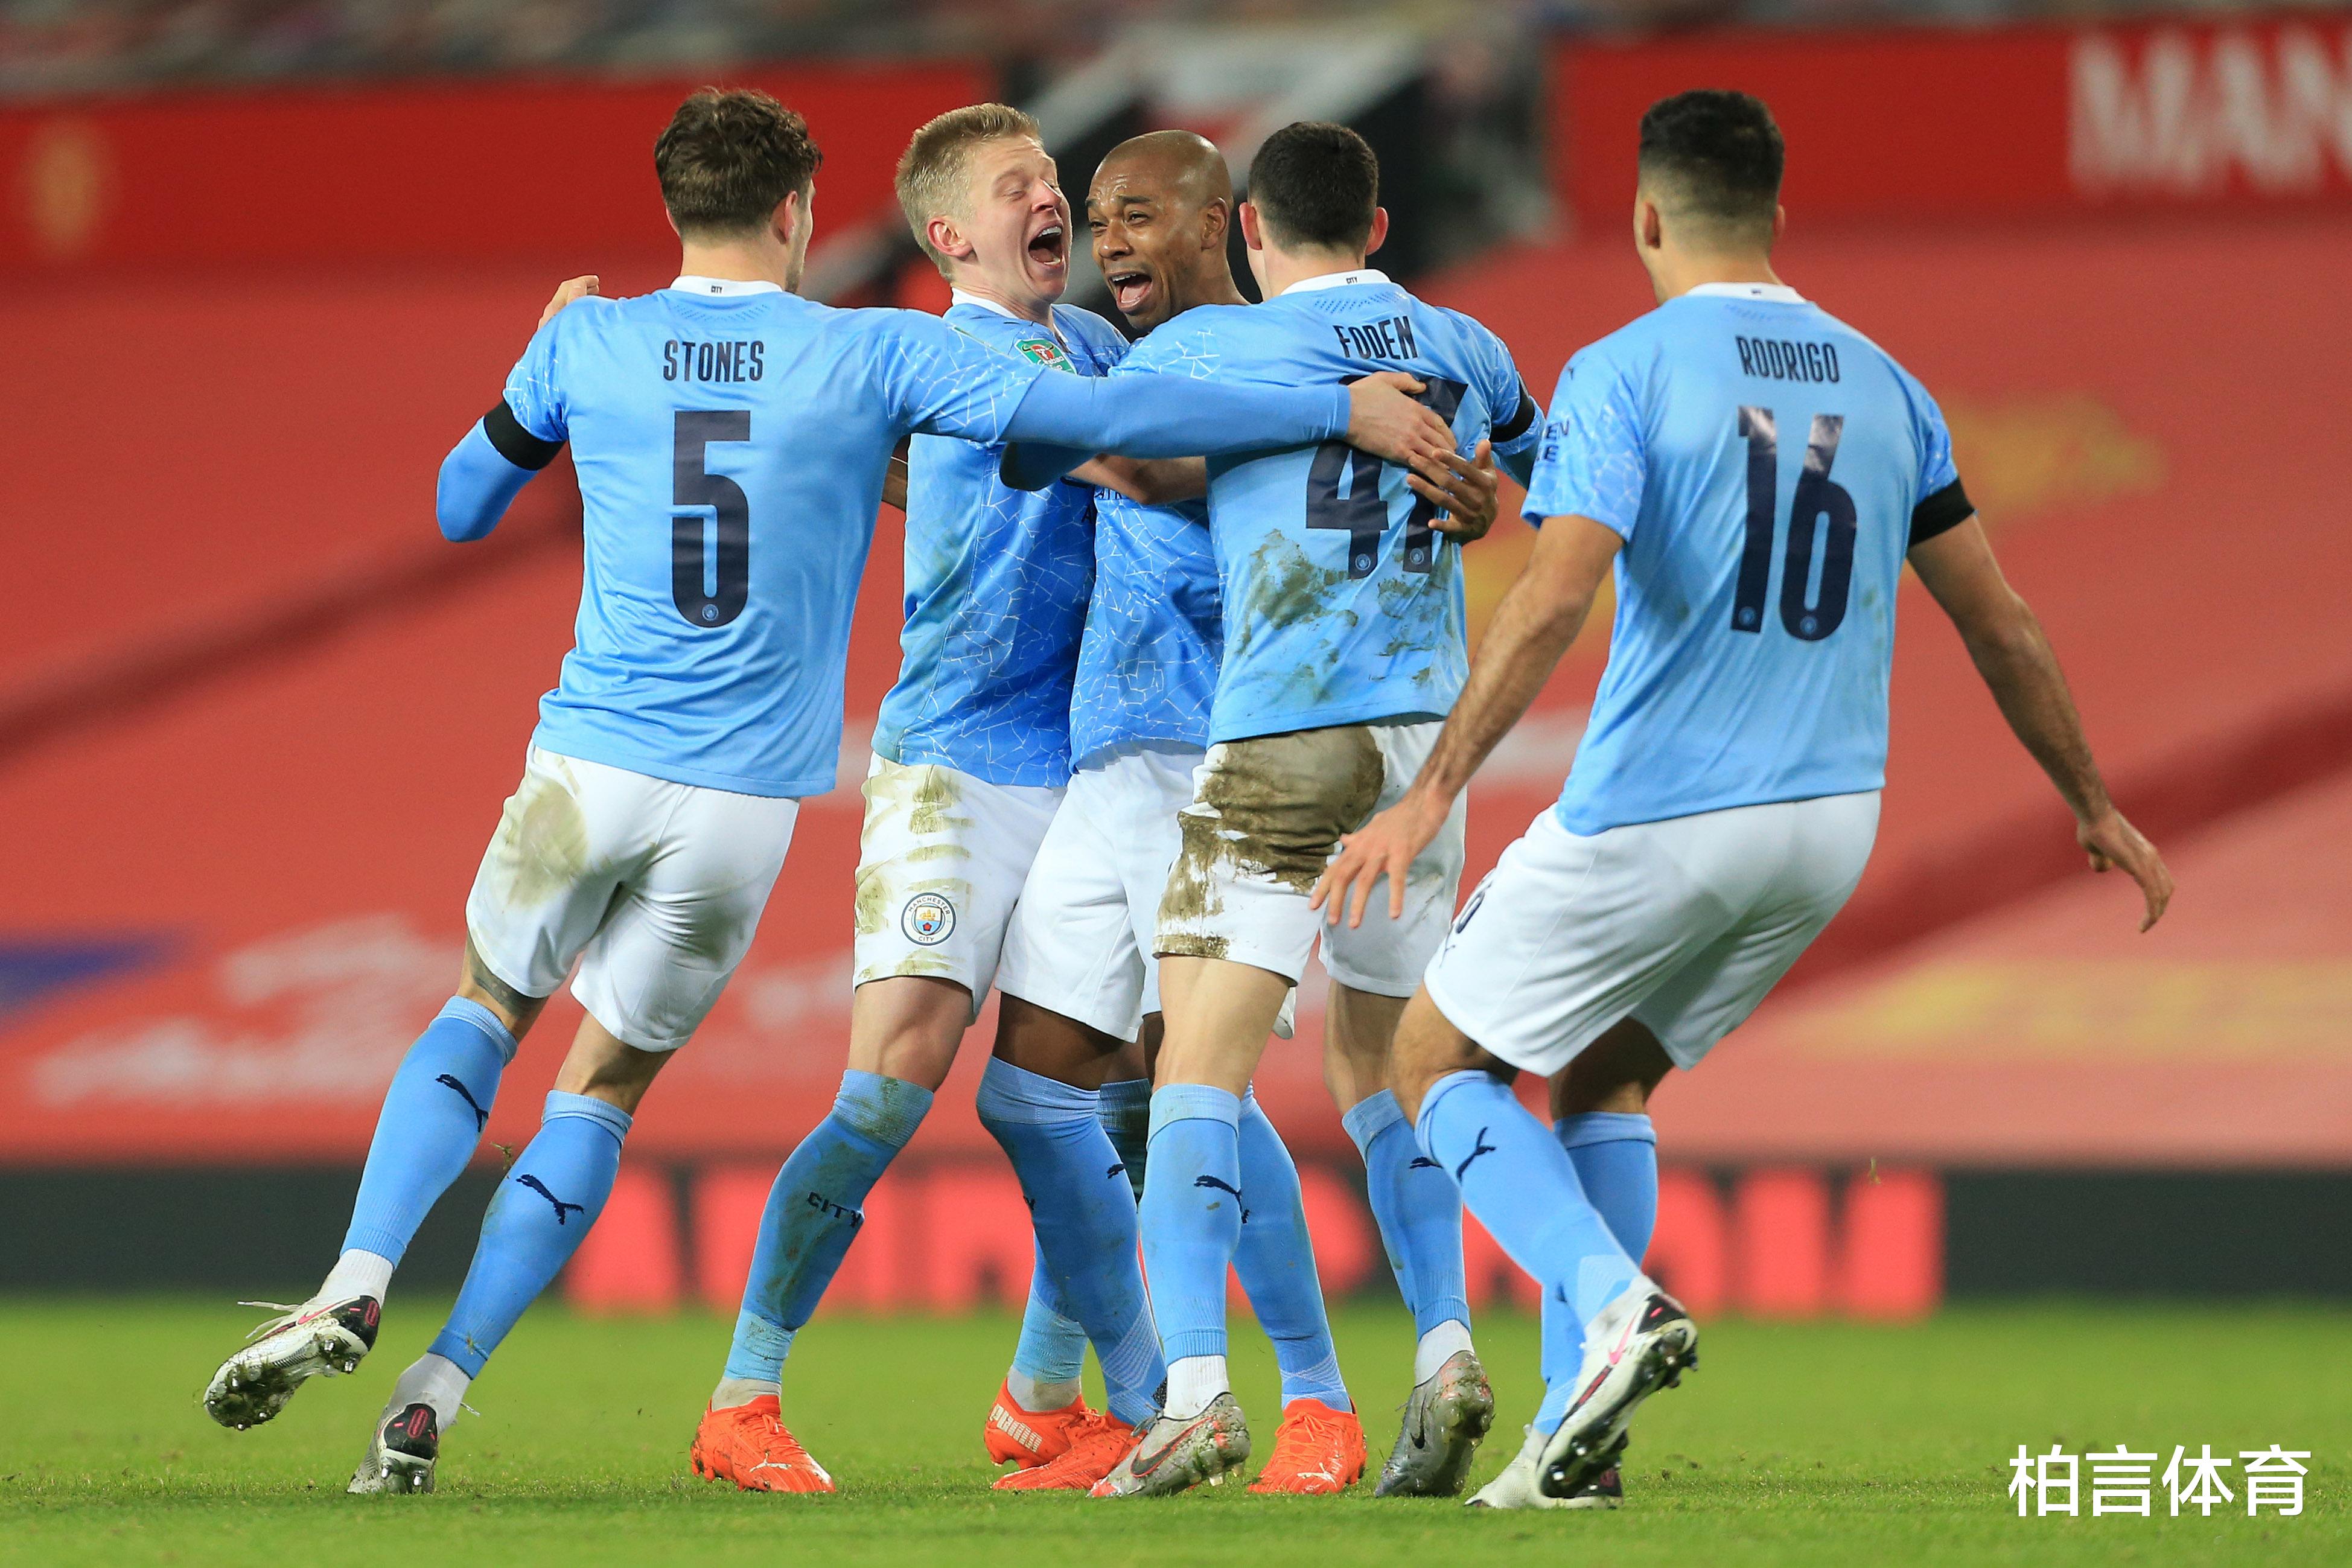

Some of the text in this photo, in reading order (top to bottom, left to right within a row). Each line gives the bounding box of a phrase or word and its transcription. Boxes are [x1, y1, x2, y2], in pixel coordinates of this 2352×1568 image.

[1332, 315, 1418, 360] FODEN
[1735, 335, 1841, 384] RODRIGO
[663, 339, 765, 382] STONES
[672, 410, 751, 628] 5
[1730, 405, 1857, 642] 16
[908, 896, 951, 915] MANCHESTER
[807, 1191, 862, 1229] CITY
